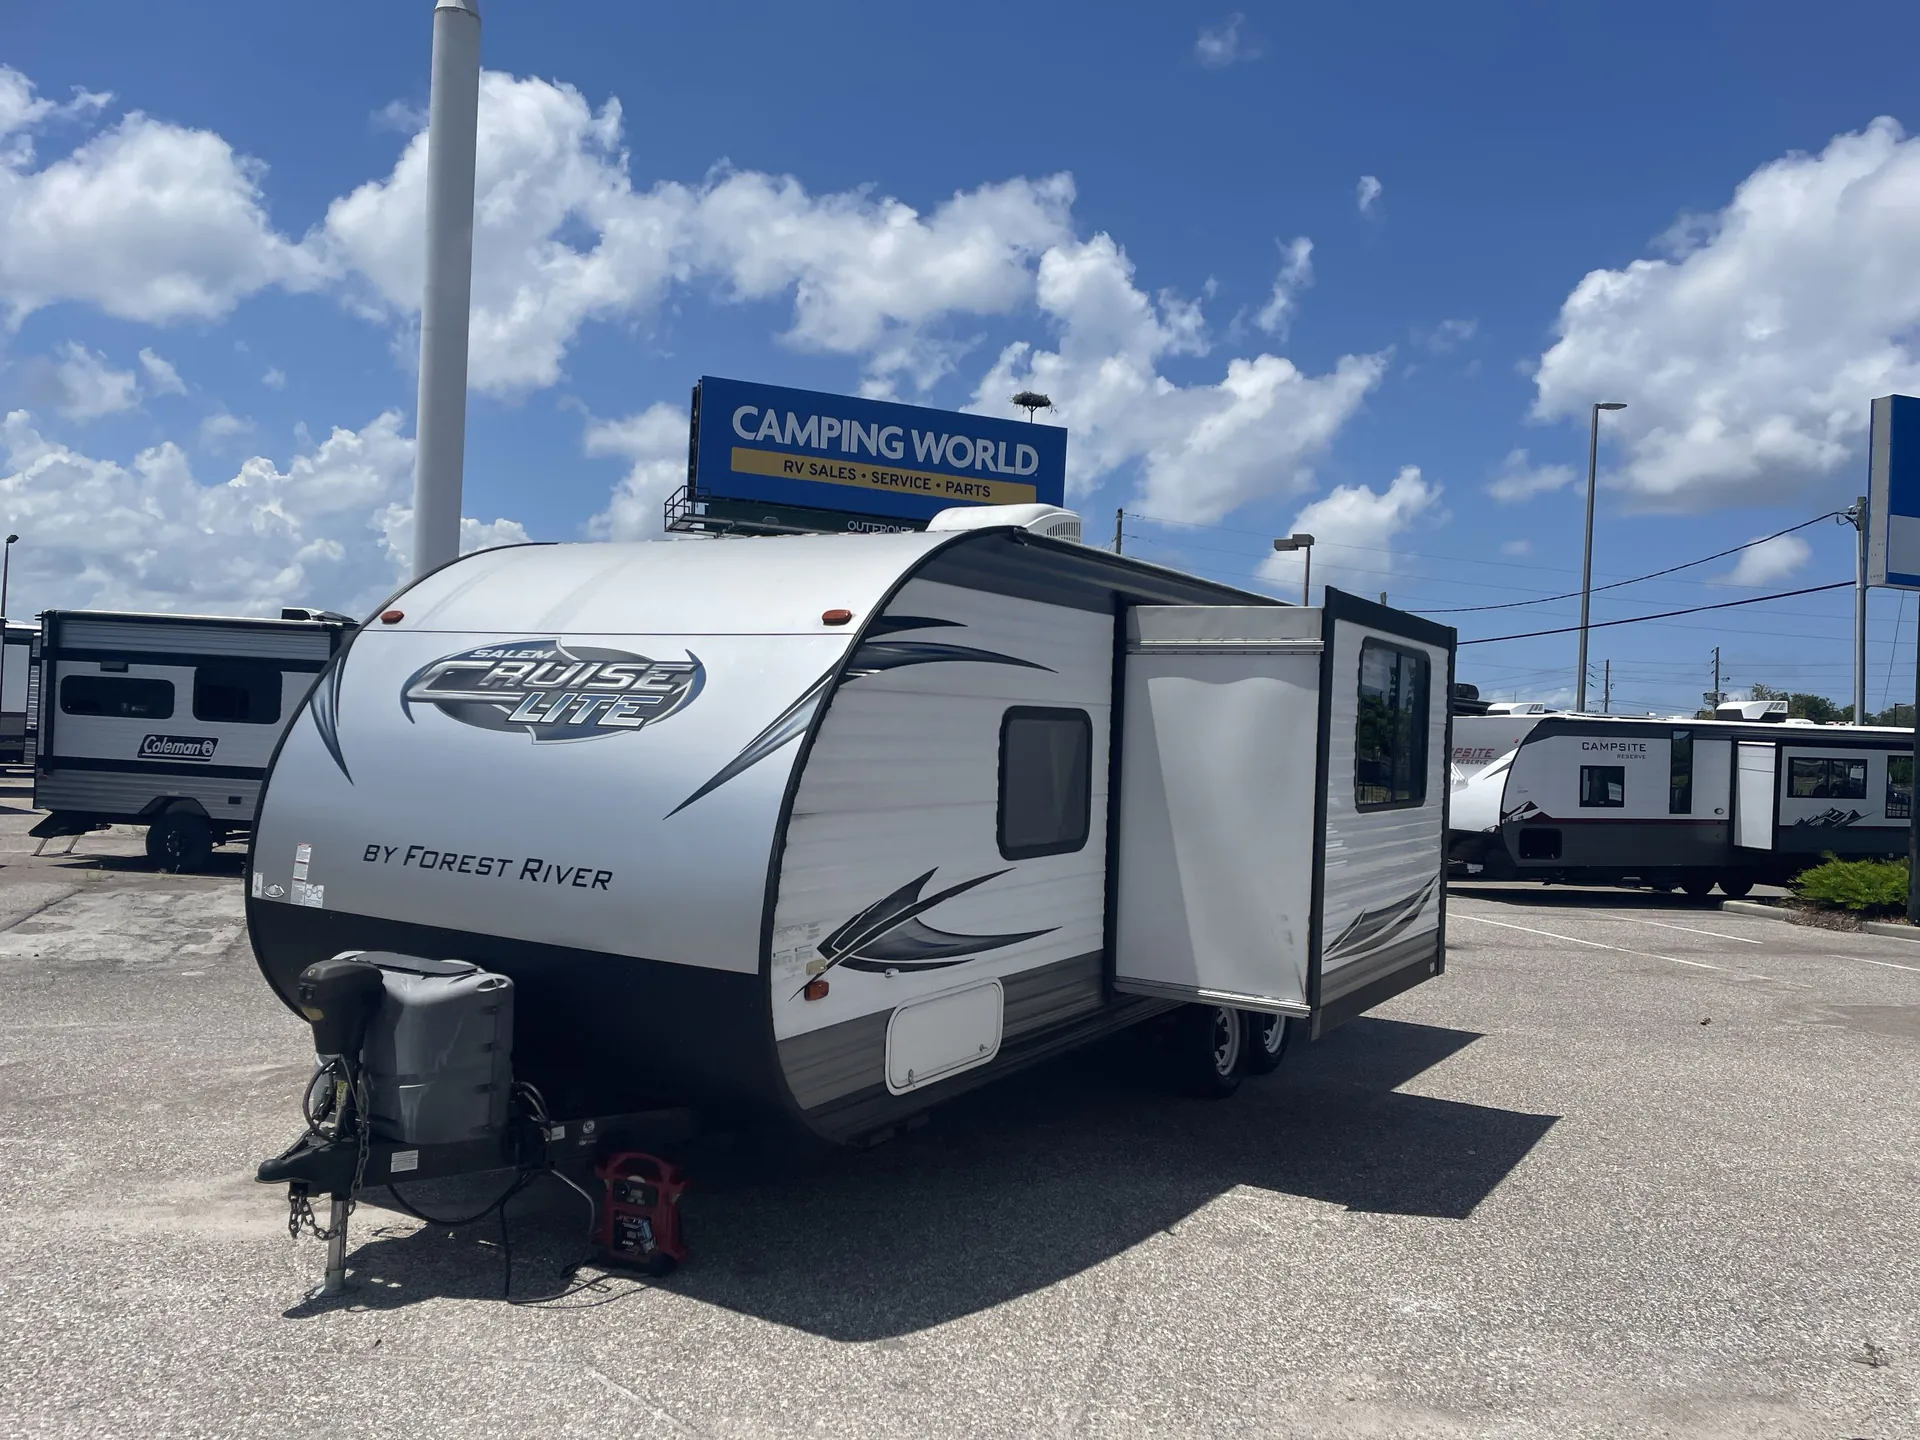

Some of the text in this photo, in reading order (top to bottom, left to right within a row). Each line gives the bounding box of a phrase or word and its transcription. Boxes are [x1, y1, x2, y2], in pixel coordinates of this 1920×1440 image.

[732, 405, 1039, 477] CAMPING WORLD
[783, 460, 991, 498] RV SALES SERVICE PARTS
[470, 649, 556, 659] SALEM
[405, 660, 698, 701] CRUISE
[507, 691, 664, 729] LITE
[143, 735, 201, 755] Coleman
[1452, 747, 1496, 758] PSITE
[1581, 742, 1647, 752] CAMPSITE
[362, 844, 614, 891] BY FOREST RIVER
